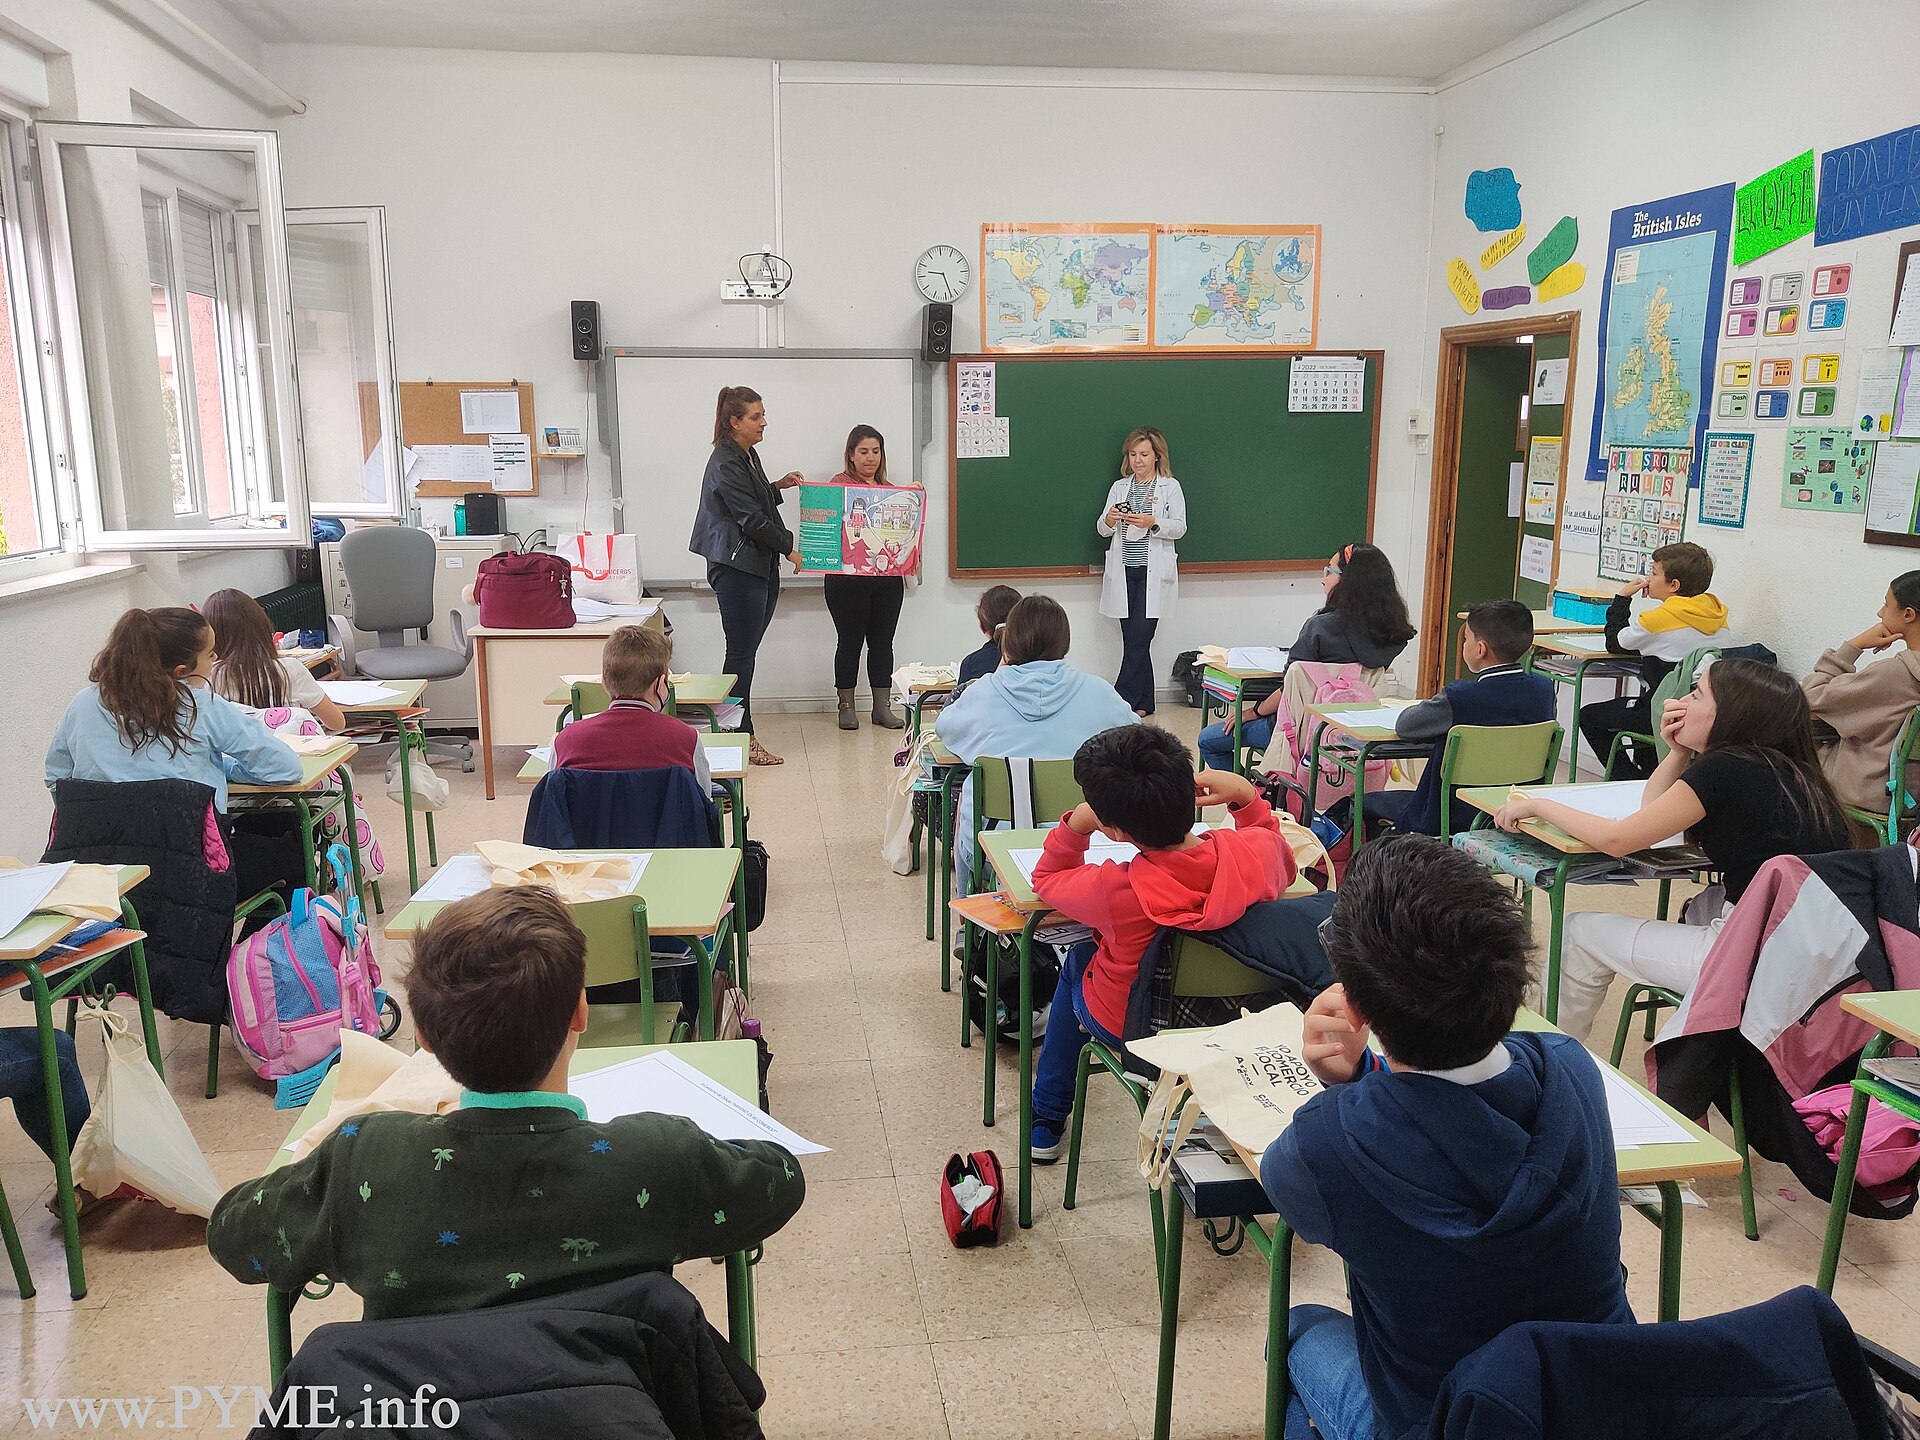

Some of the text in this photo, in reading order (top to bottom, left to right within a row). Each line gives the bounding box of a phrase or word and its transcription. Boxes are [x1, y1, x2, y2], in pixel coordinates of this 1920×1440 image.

[1631, 211, 1702, 239] British Isles
[1634, 211, 1649, 223] The
[1731, 441, 1748, 449] CLASS
[1612, 452, 1687, 469] CLASSROOM
[1621, 475, 1672, 492] RULES
[1254, 1052, 1283, 1088] LOCAL
[1266, 1050, 1310, 1096] COMERCIO
[1275, 1044, 1318, 1089] YO APOYO
